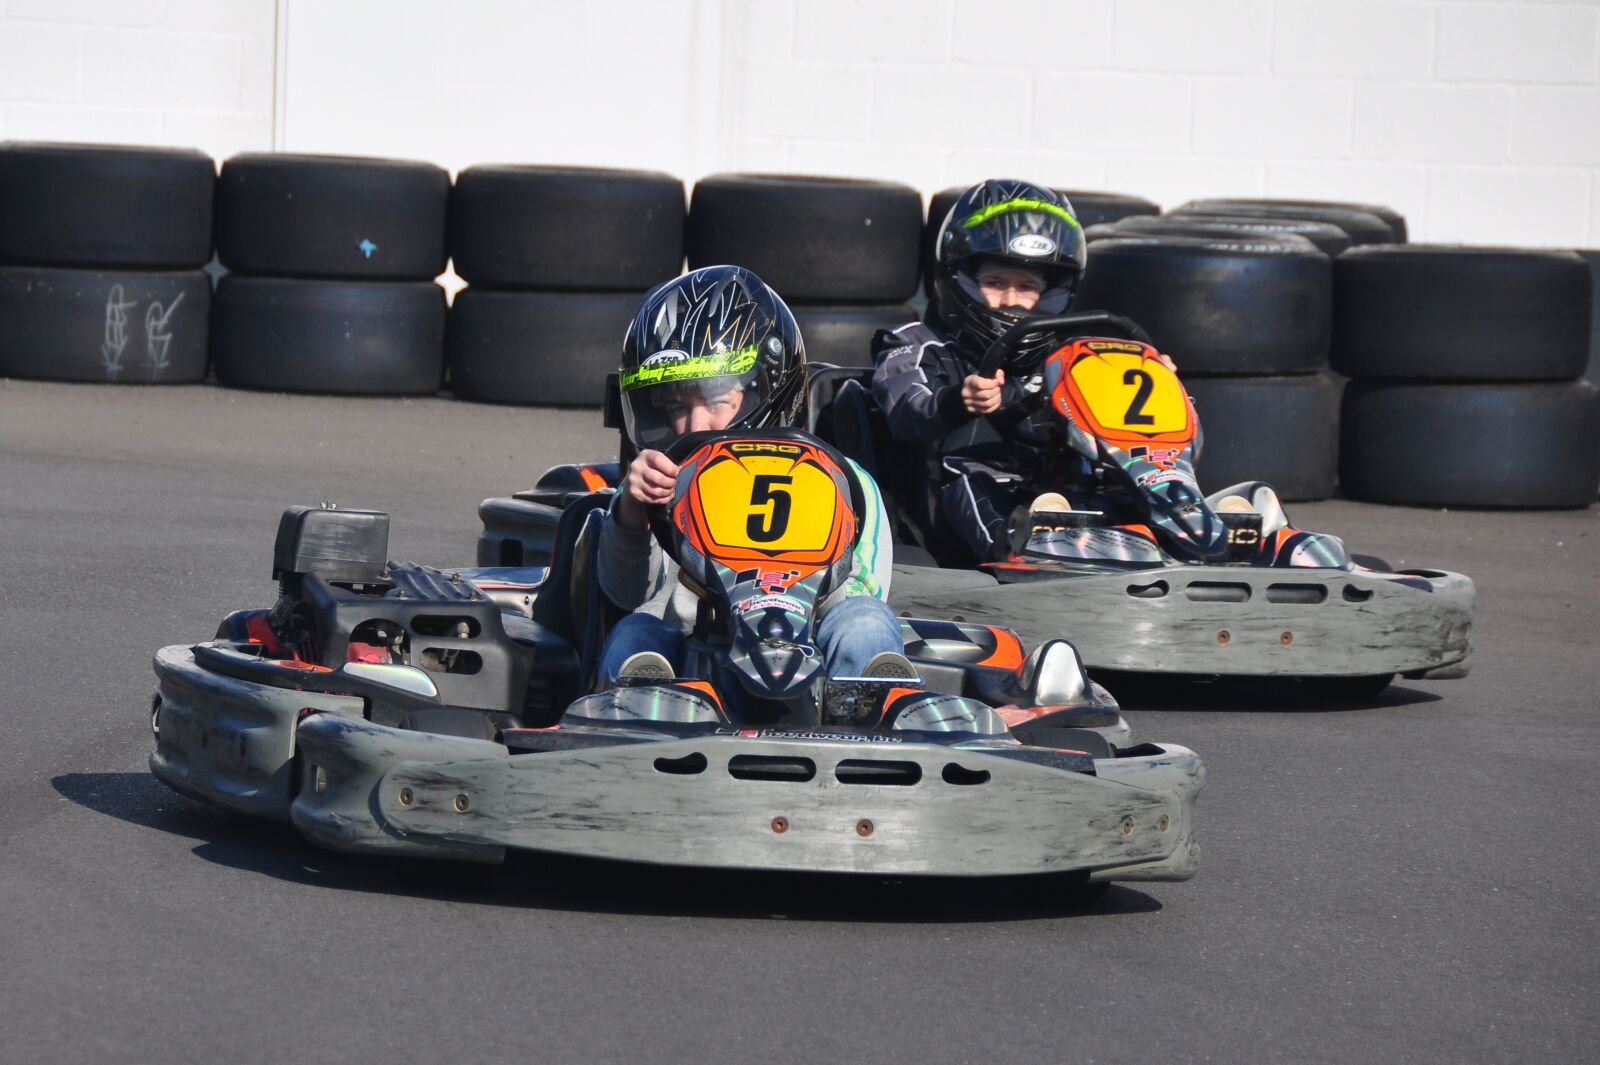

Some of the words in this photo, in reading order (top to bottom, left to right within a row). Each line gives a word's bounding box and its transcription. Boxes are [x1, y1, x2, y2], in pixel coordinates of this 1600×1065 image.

[1123, 368, 1155, 425] 2
[731, 443, 801, 454] CRG
[746, 474, 793, 543] 5
